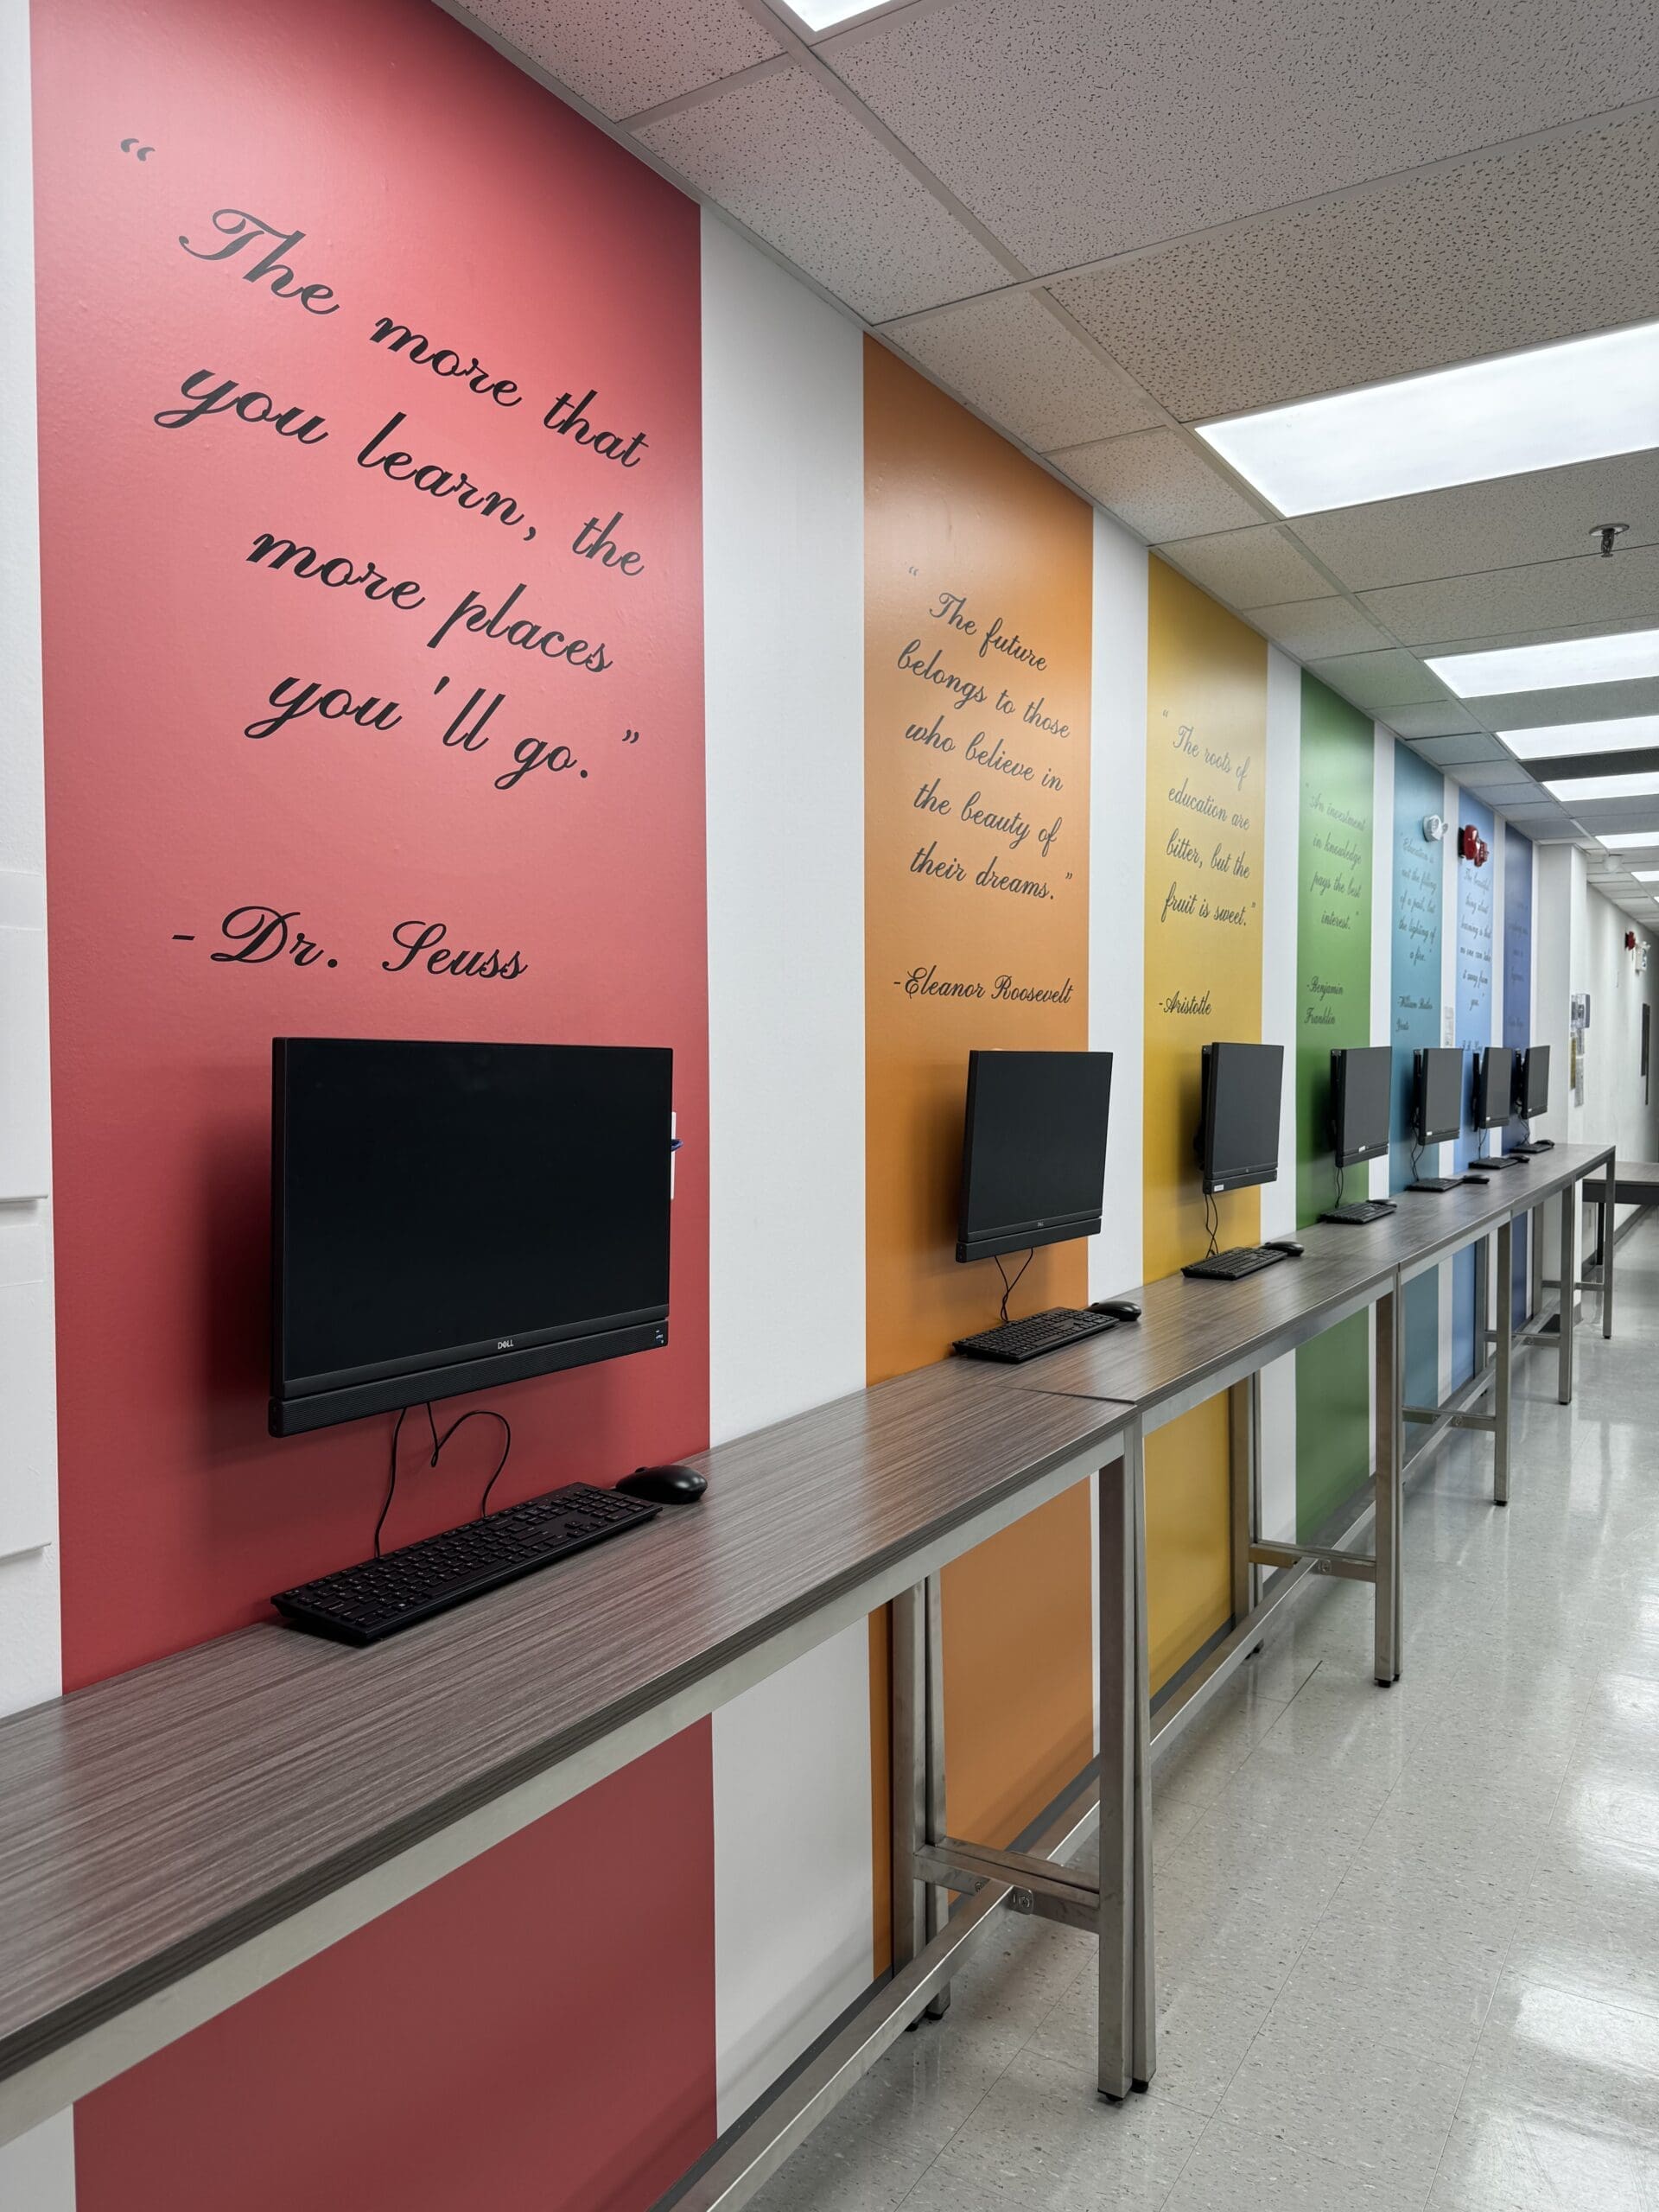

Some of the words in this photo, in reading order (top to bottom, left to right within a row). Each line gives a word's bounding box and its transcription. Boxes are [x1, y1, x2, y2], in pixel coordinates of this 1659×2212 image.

[178, 209, 340, 315] The
[369, 316, 522, 407] more
[543, 389, 649, 467] that
[154, 369, 329, 444] you
[356, 411, 537, 541] learn,
[571, 512, 645, 575] the
[245, 533, 426, 609] more
[426, 583, 613, 672] places
[929, 592, 977, 635] The
[979, 617, 1047, 671] future
[897, 639, 988, 709] belongs
[995, 690, 1016, 714] to
[1023, 697, 1071, 738] those
[905, 715, 956, 752] who
[965, 731, 1034, 781] believe
[1041, 768, 1064, 791] in
[1173, 725, 1199, 758] The
[1205, 748, 1230, 772] roots
[1236, 756, 1250, 791] of
[913, 778, 952, 815] the
[961, 791, 1031, 849] beauty
[1039, 817, 1063, 857] of
[1168, 778, 1228, 822] education
[1231, 813, 1250, 830] are
[910, 841, 967, 881] their
[1166, 828, 1204, 868] bitter,
[1210, 843, 1231, 873] but
[1233, 850, 1250, 879] the
[1161, 881, 1198, 923] fruit
[1198, 899, 1210, 918] is
[381, 920, 528, 980] Seuss
[991, 975, 1074, 1004] Roosevelt
[497, 1339, 514, 1350] DELL
